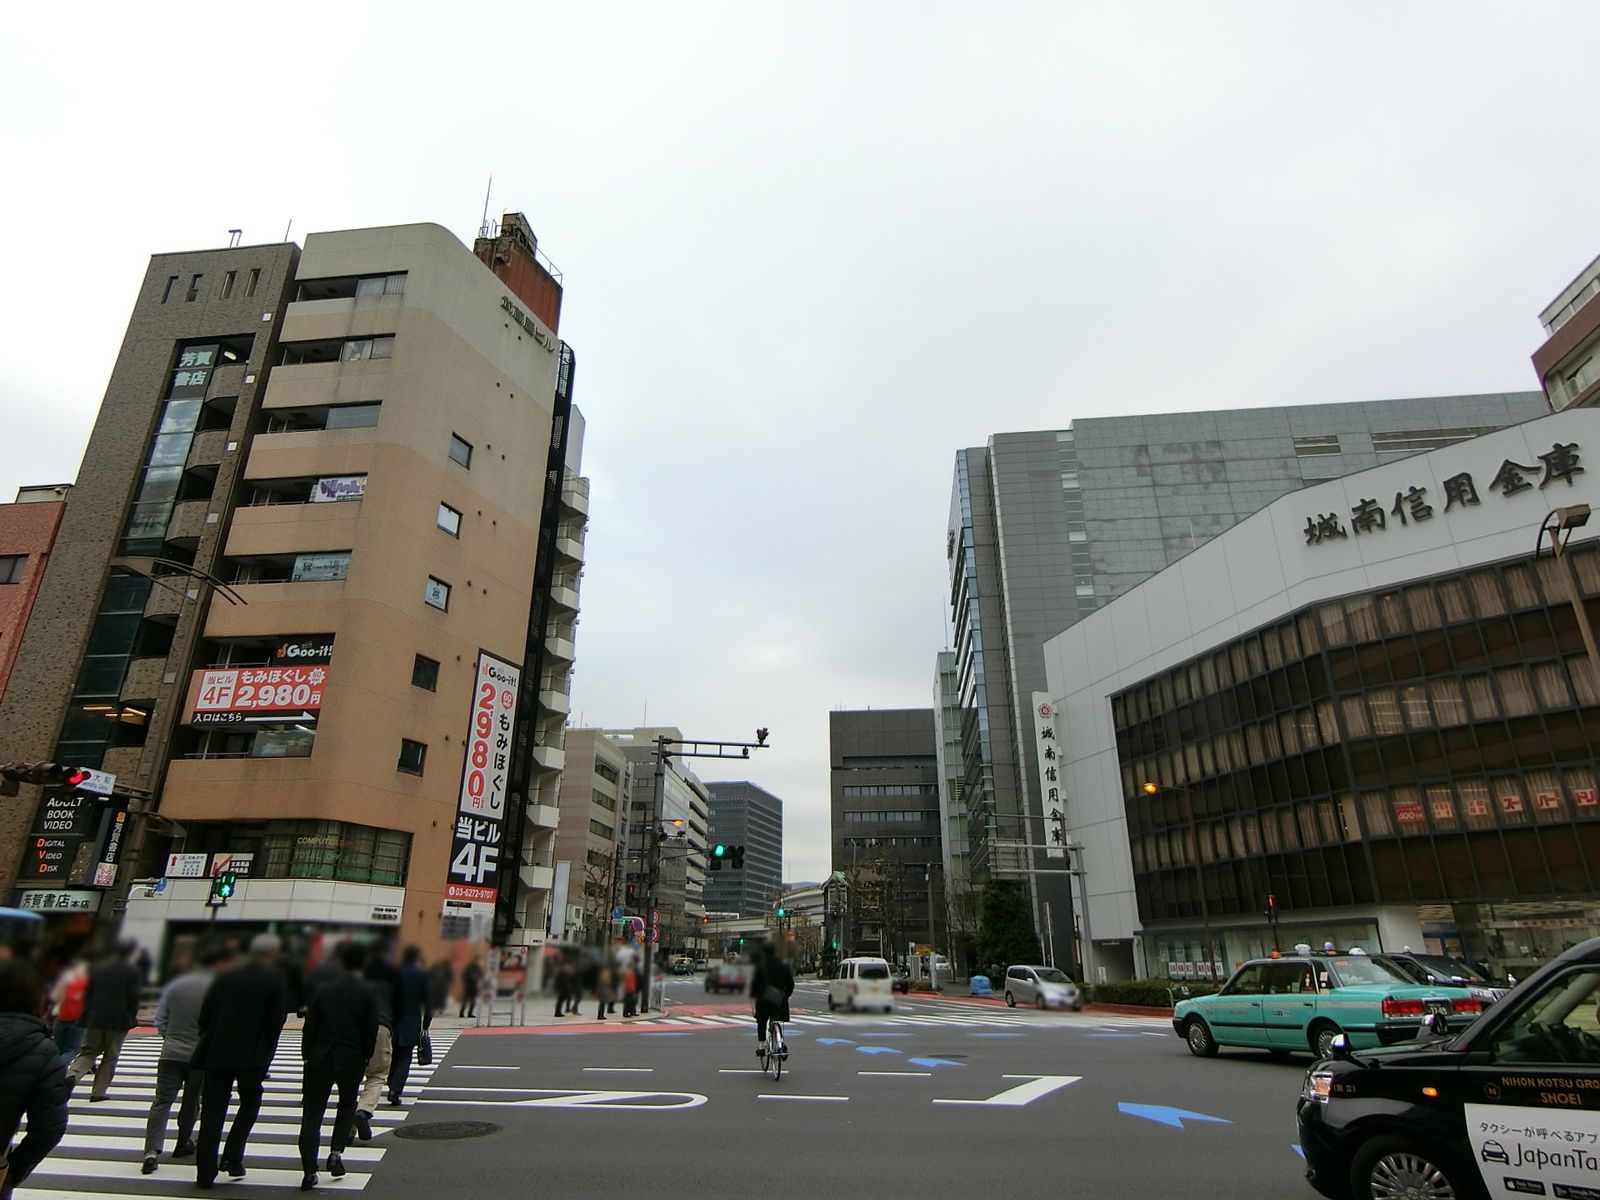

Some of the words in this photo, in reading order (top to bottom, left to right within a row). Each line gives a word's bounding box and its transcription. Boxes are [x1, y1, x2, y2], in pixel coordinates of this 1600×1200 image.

[1303, 442, 1585, 547] 城南信用金庫
[287, 644, 333, 658] Goo-it!
[207, 675, 234, 685] 当ビル
[241, 669, 306, 684] もみほぐし
[488, 666, 517, 687] Goo-it!
[203, 686, 231, 705] 4F
[193, 711, 243, 723] 入口はこちら
[490, 712, 510, 810] もみほぐし
[1041, 725, 1063, 846] 城南信用金庫
[46, 797, 84, 807] ADULT
[46, 810, 75, 819] BOOK
[43, 820, 73, 830] VIDEO
[456, 816, 501, 843] 当ビル
[36, 838, 66, 848] DIGITAL
[105, 822, 124, 863] 芳賀書店
[38, 850, 63, 860] VIDEO
[39, 863, 59, 873] DISK
[451, 842, 499, 884] 4F
[1501, 1076, 1535, 1087] NIHON
[1538, 1078, 1573, 1089] KOTSU
[1540, 1092, 1583, 1105] SHOEI
[1513, 1142, 1600, 1171] JapanTa
